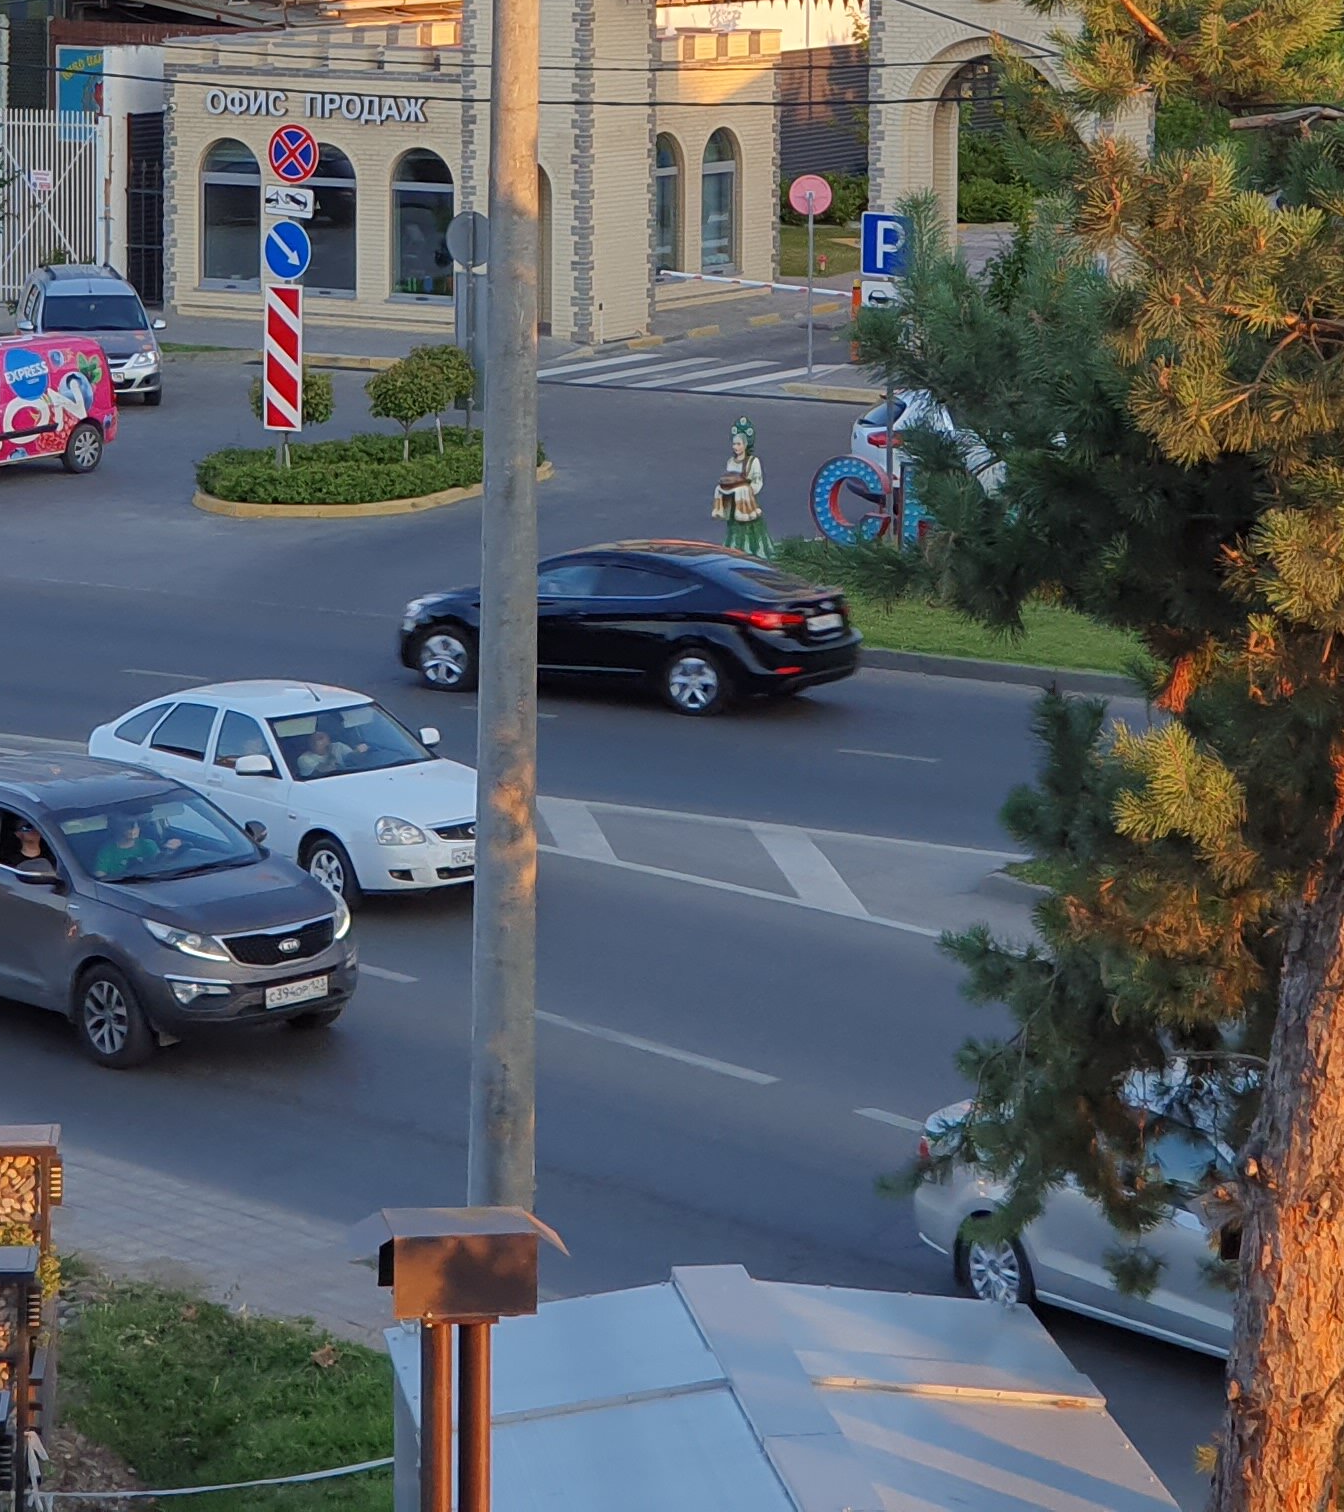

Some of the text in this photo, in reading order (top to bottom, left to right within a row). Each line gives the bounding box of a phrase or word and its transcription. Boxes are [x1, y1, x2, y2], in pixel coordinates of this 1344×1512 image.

[206, 89, 428, 125] ОФИС ПРОДАЖ
[4, 361, 49, 385] EXPRESS
